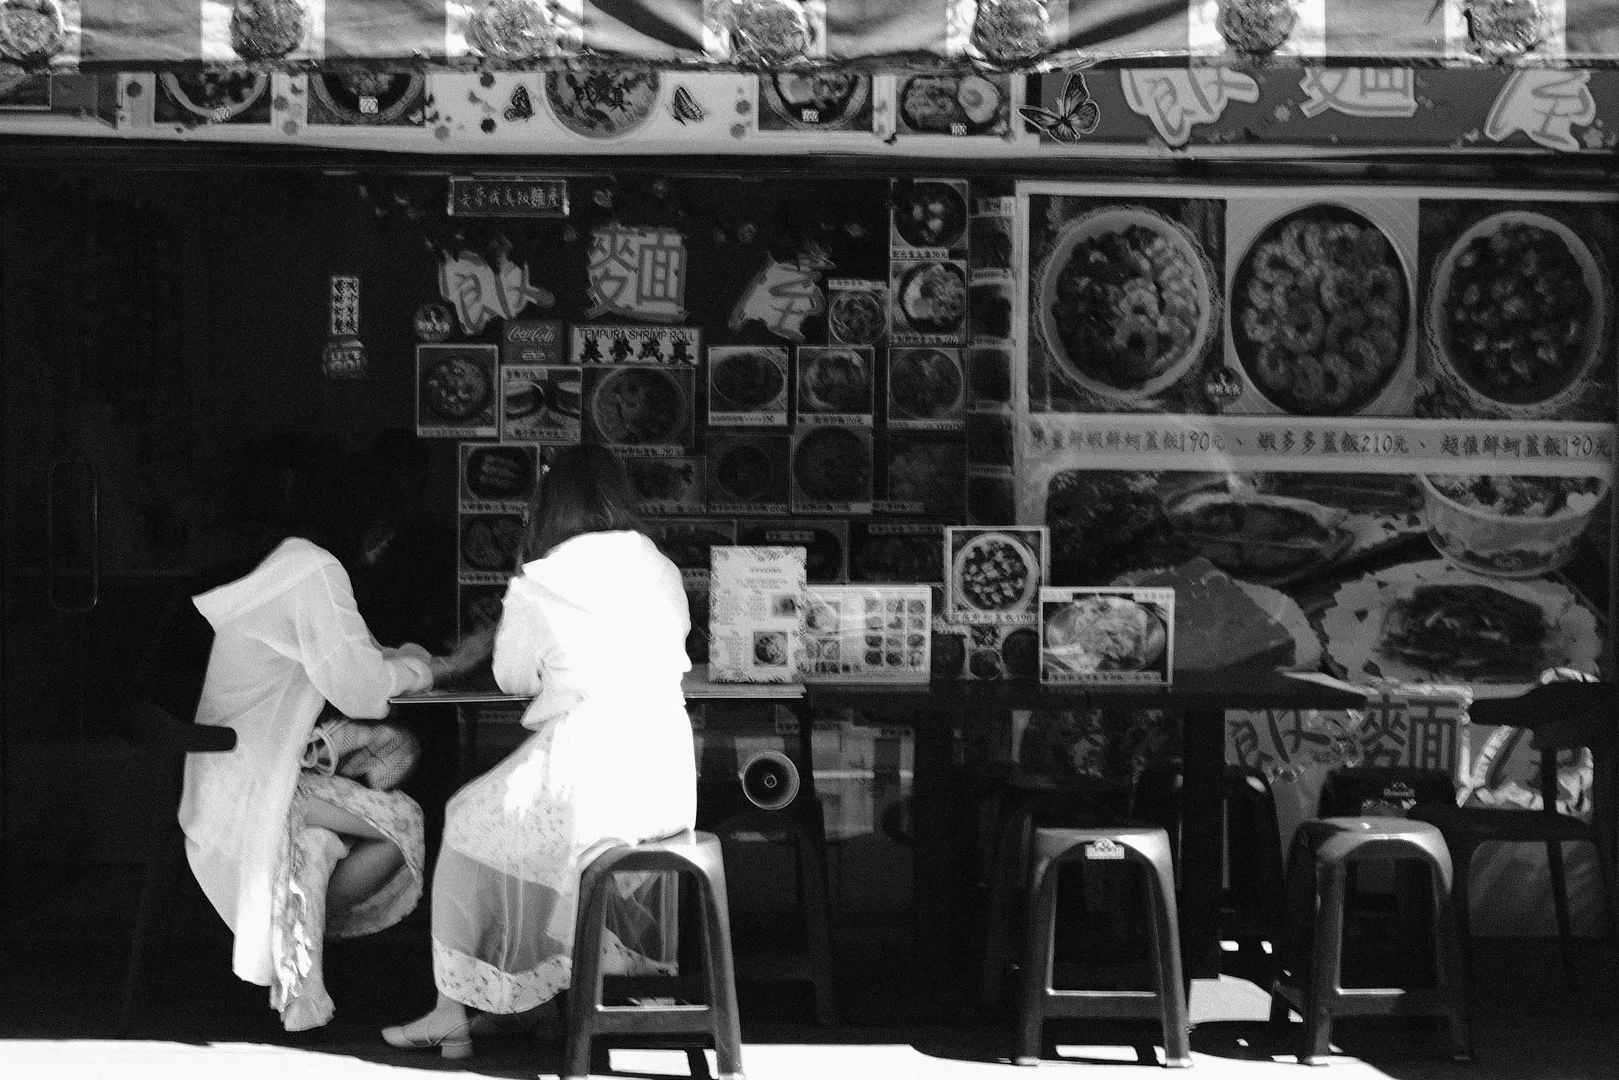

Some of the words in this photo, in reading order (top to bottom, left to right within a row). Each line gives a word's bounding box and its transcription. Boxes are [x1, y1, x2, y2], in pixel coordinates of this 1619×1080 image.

[578, 328, 626, 340] TEMPURA
[629, 329, 667, 340] SHRIMP
[670, 331, 696, 342] ROLL
[578, 336, 697, 365] 美夢成真
